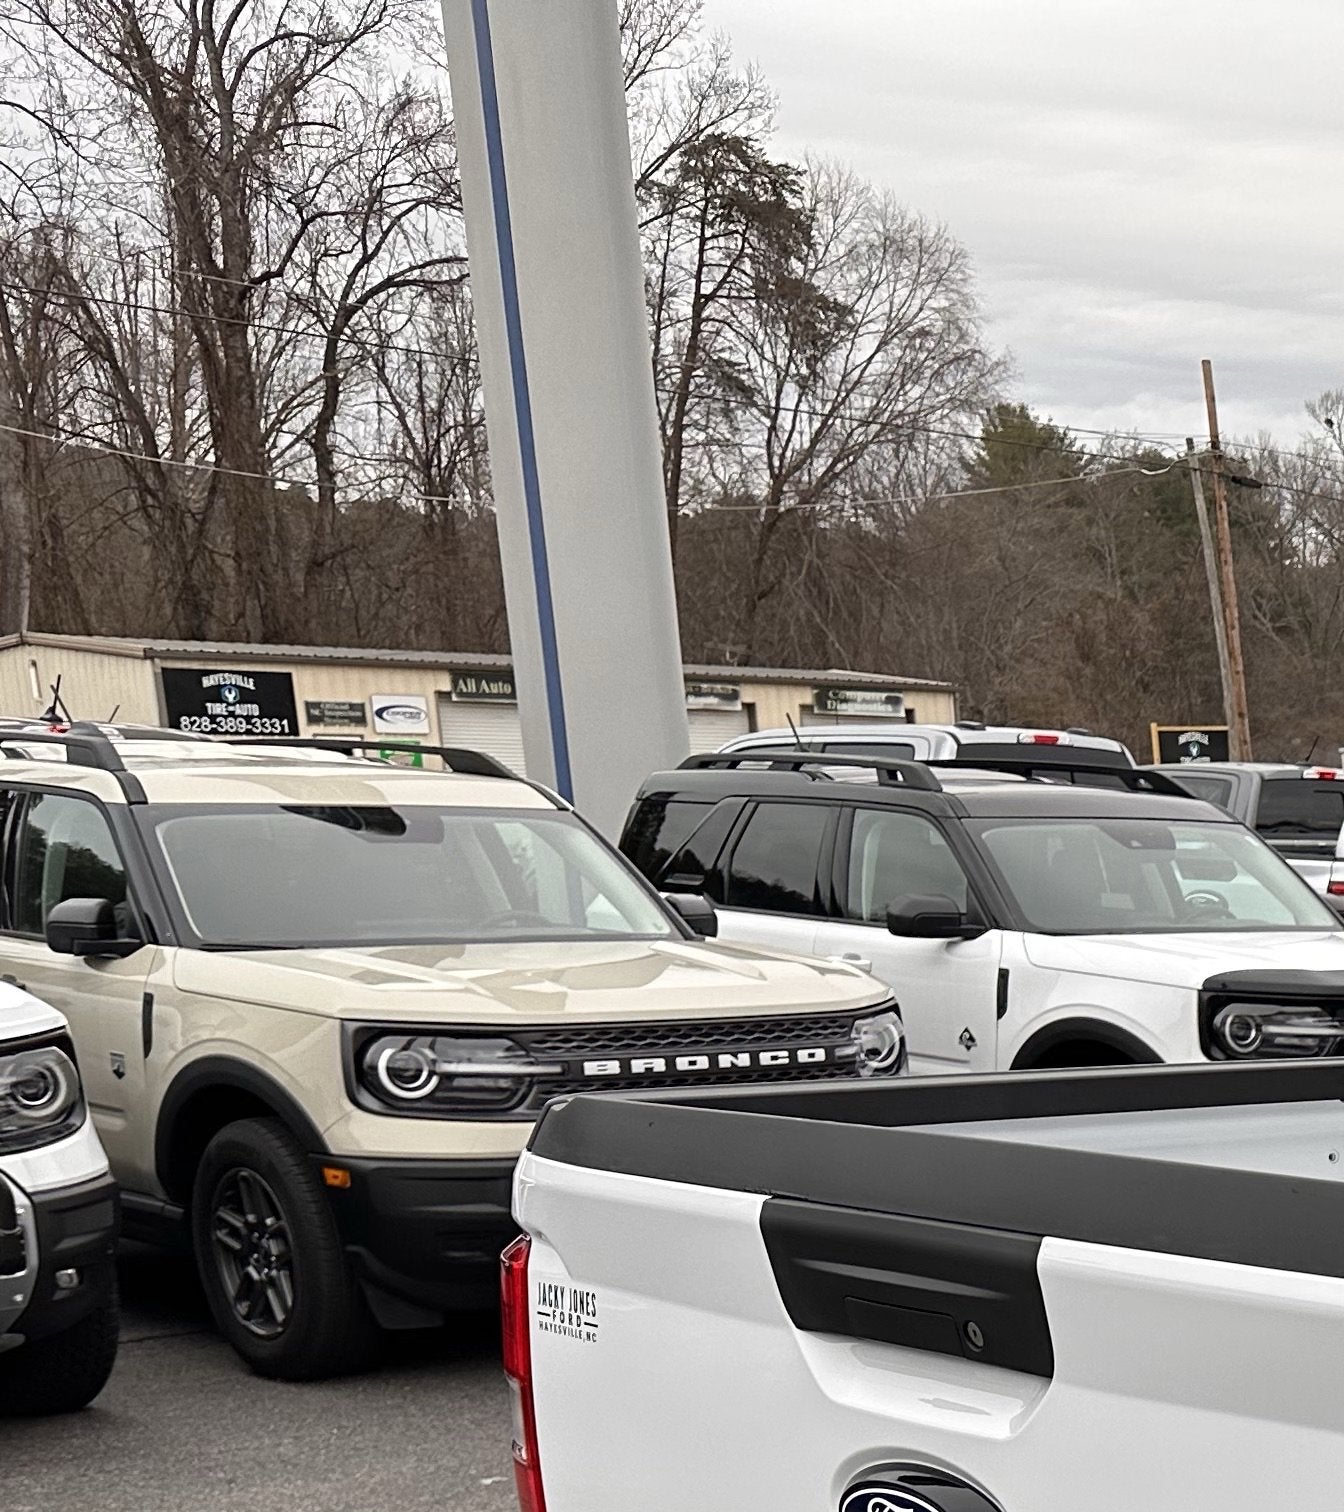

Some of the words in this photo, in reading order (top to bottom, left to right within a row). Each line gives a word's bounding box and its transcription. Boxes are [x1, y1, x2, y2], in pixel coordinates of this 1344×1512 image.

[202, 672, 256, 690] HAYESVILLE
[456, 678, 477, 693] All
[479, 680, 512, 694] Auto
[205, 702, 228, 715] TIRE
[235, 703, 259, 716] AUTO
[180, 716, 289, 733] 828-389-3331
[583, 1048, 826, 1076] BRONCO
[538, 1282, 565, 1309] JACKY
[569, 1288, 597, 1317] JONES
[553, 1310, 581, 1327] FORD
